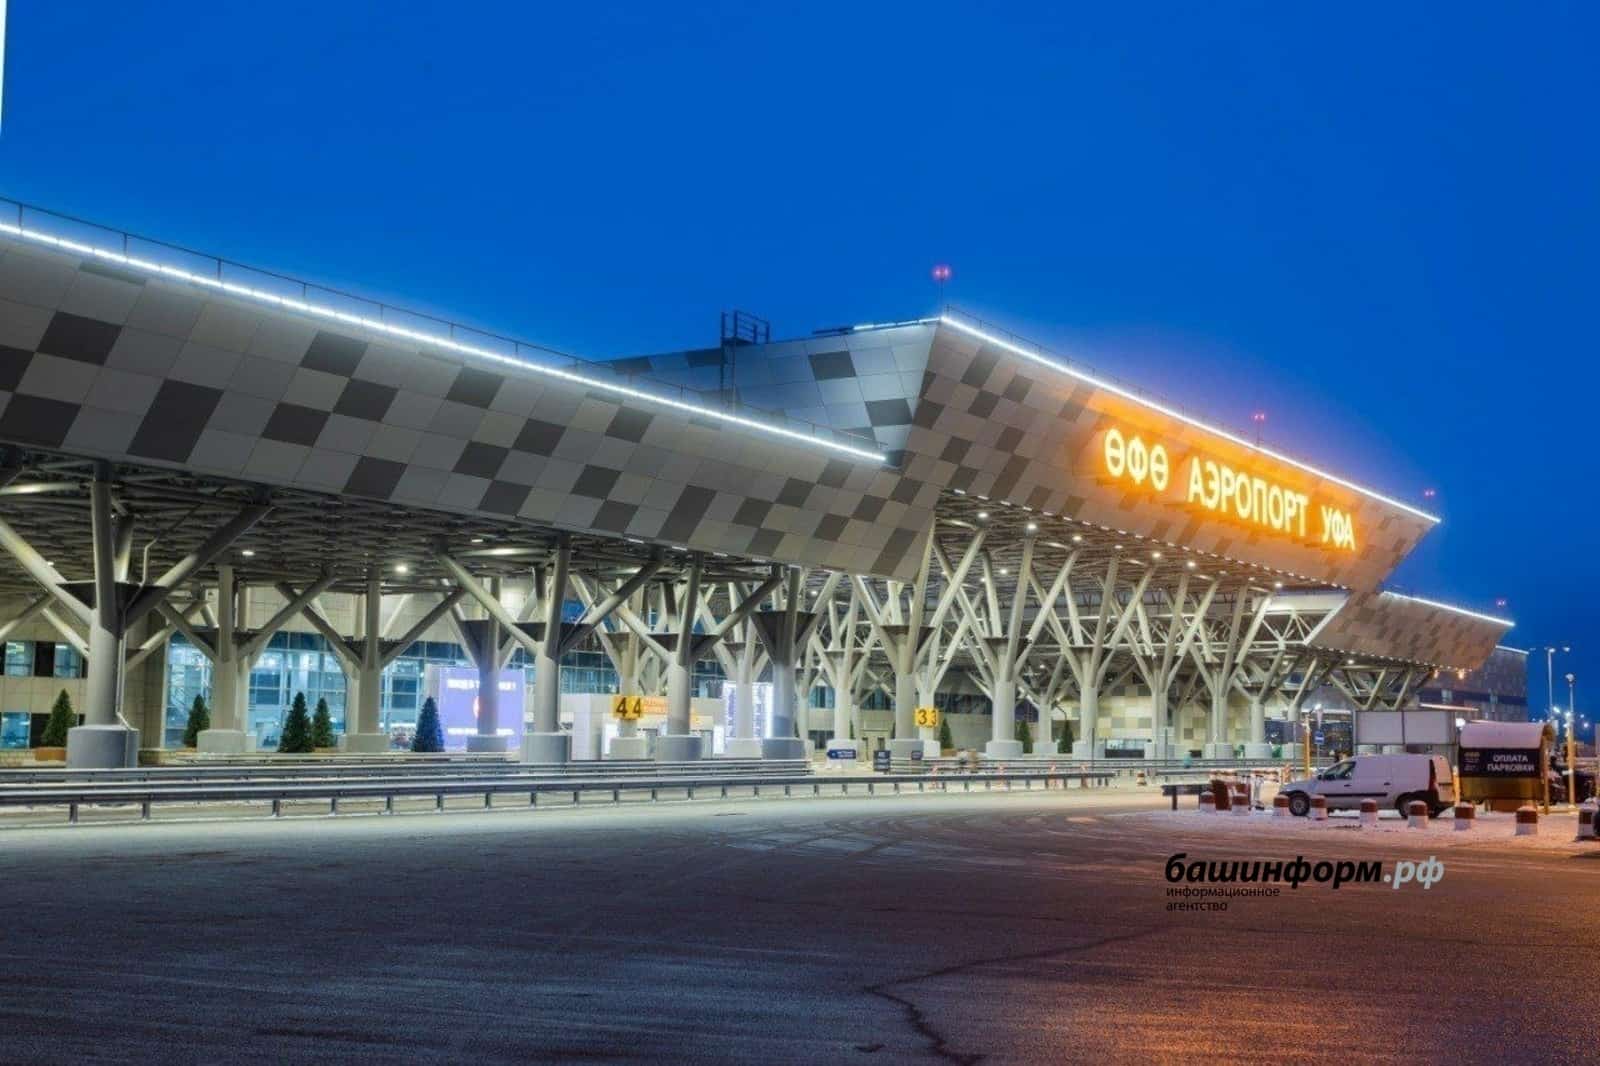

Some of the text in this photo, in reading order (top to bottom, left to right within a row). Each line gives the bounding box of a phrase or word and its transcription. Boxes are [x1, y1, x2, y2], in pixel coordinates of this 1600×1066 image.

[1187, 455, 1309, 537] АЭРОПОРТ
[1321, 505, 1356, 551] УФА
[1492, 754, 1529, 762] ОПЛАТА
[1487, 763, 1535, 772] ПАРКОВКИ
